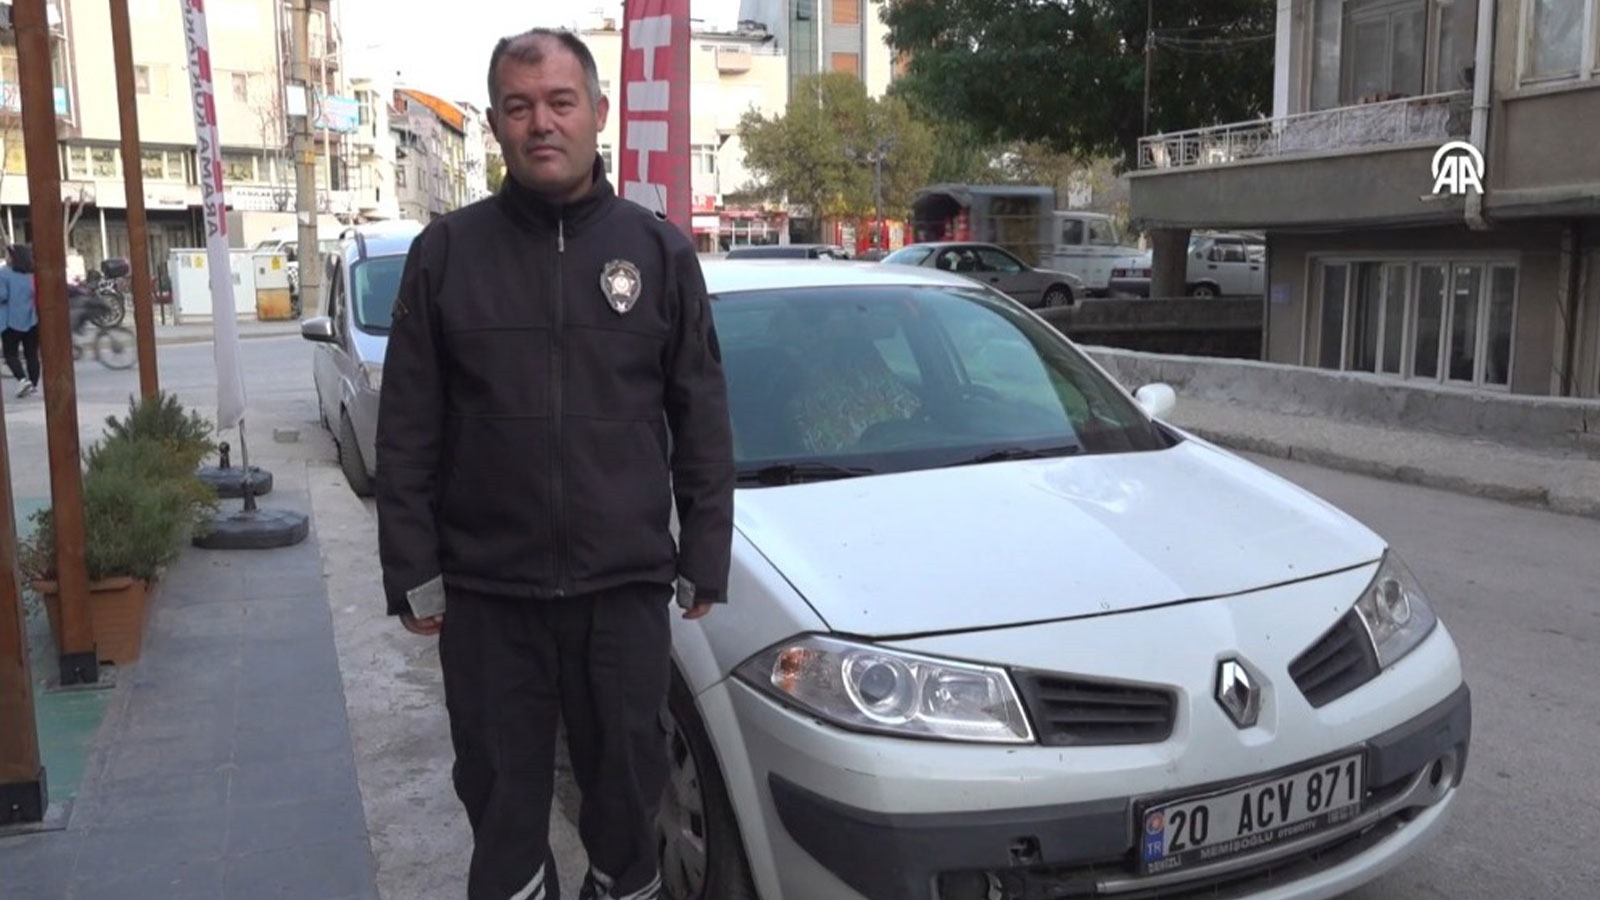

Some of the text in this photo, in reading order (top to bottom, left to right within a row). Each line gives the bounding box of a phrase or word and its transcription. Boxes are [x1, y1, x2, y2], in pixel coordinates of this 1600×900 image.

[1147, 760, 1356, 856] TR 20 ACV 871
